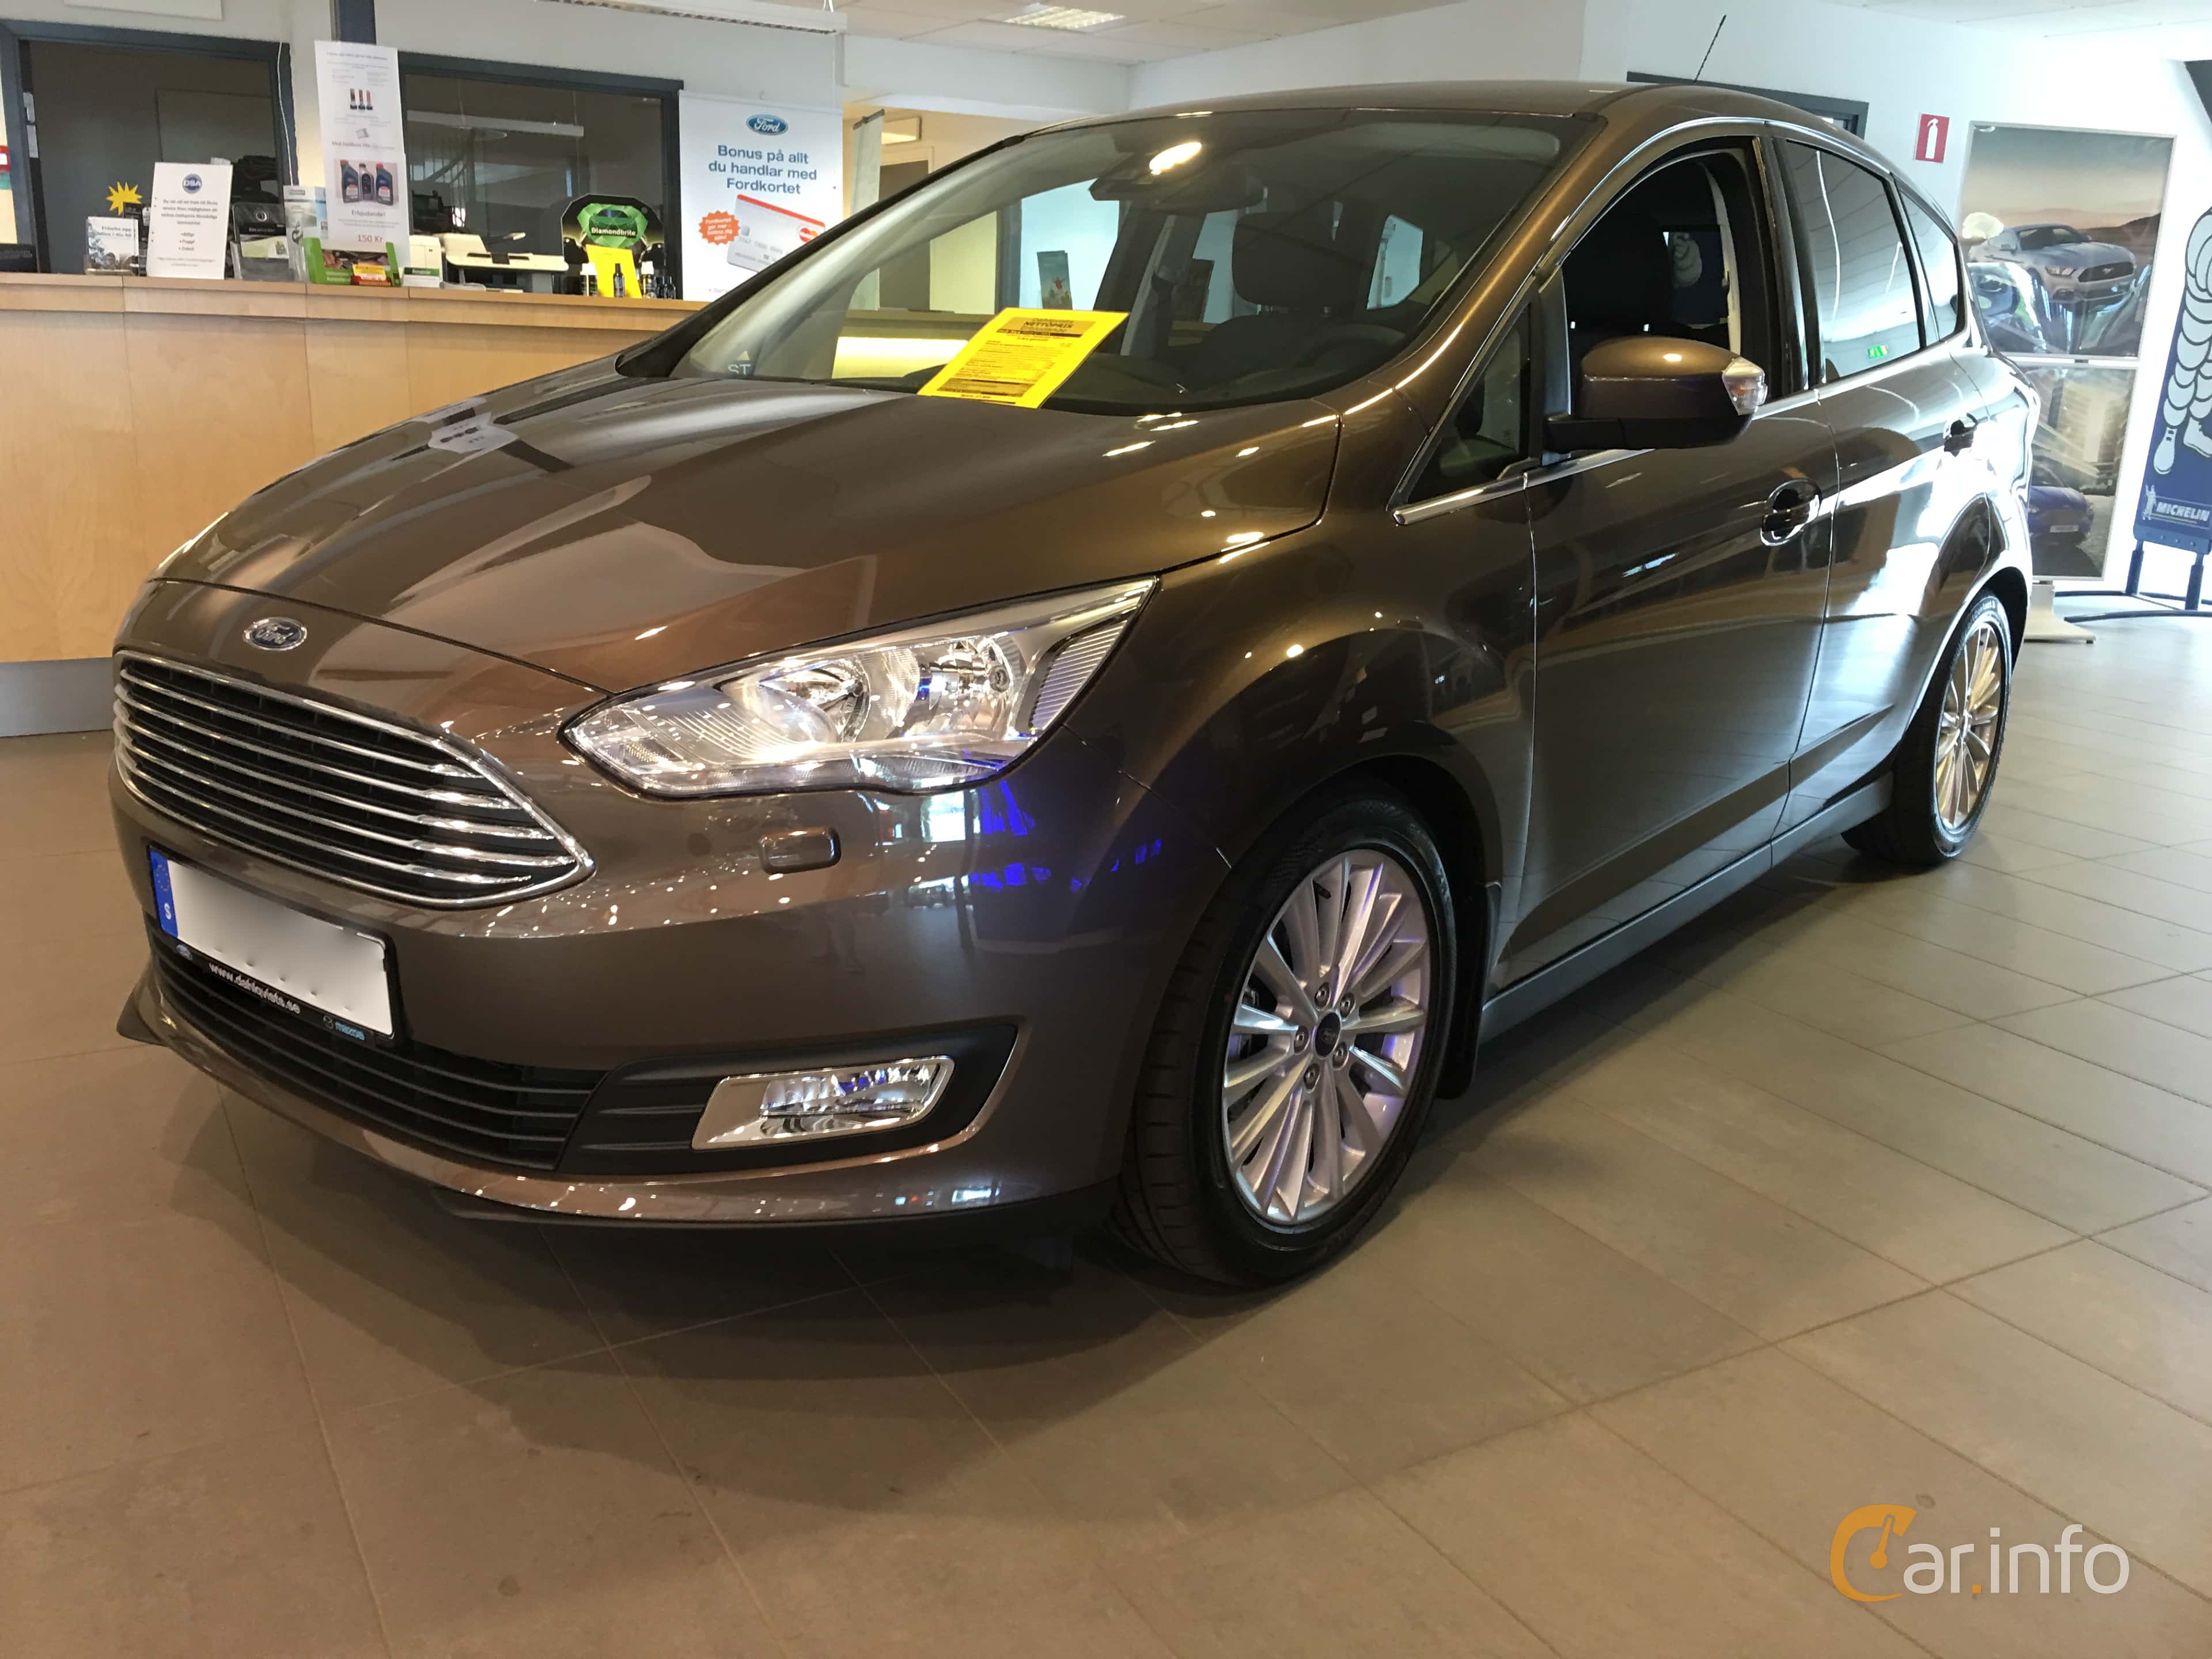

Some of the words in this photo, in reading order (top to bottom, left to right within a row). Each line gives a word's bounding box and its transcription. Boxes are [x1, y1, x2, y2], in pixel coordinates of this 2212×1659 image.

[752, 117, 782, 133] Ford
[718, 145, 763, 160] Bonus
[767, 149, 784, 164] på
[788, 152, 809, 164] allt
[709, 160, 726, 172] du
[730, 162, 783, 177] handlar
[787, 169, 817, 180] med
[727, 177, 801, 194] Fordkortet
[358, 234, 372, 243] 150
[375, 235, 383, 243] Kr
[591, 227, 636, 236] Diamondbrite
[2156, 502, 2210, 521] MICHELIN
[164, 903, 172, 920] S
